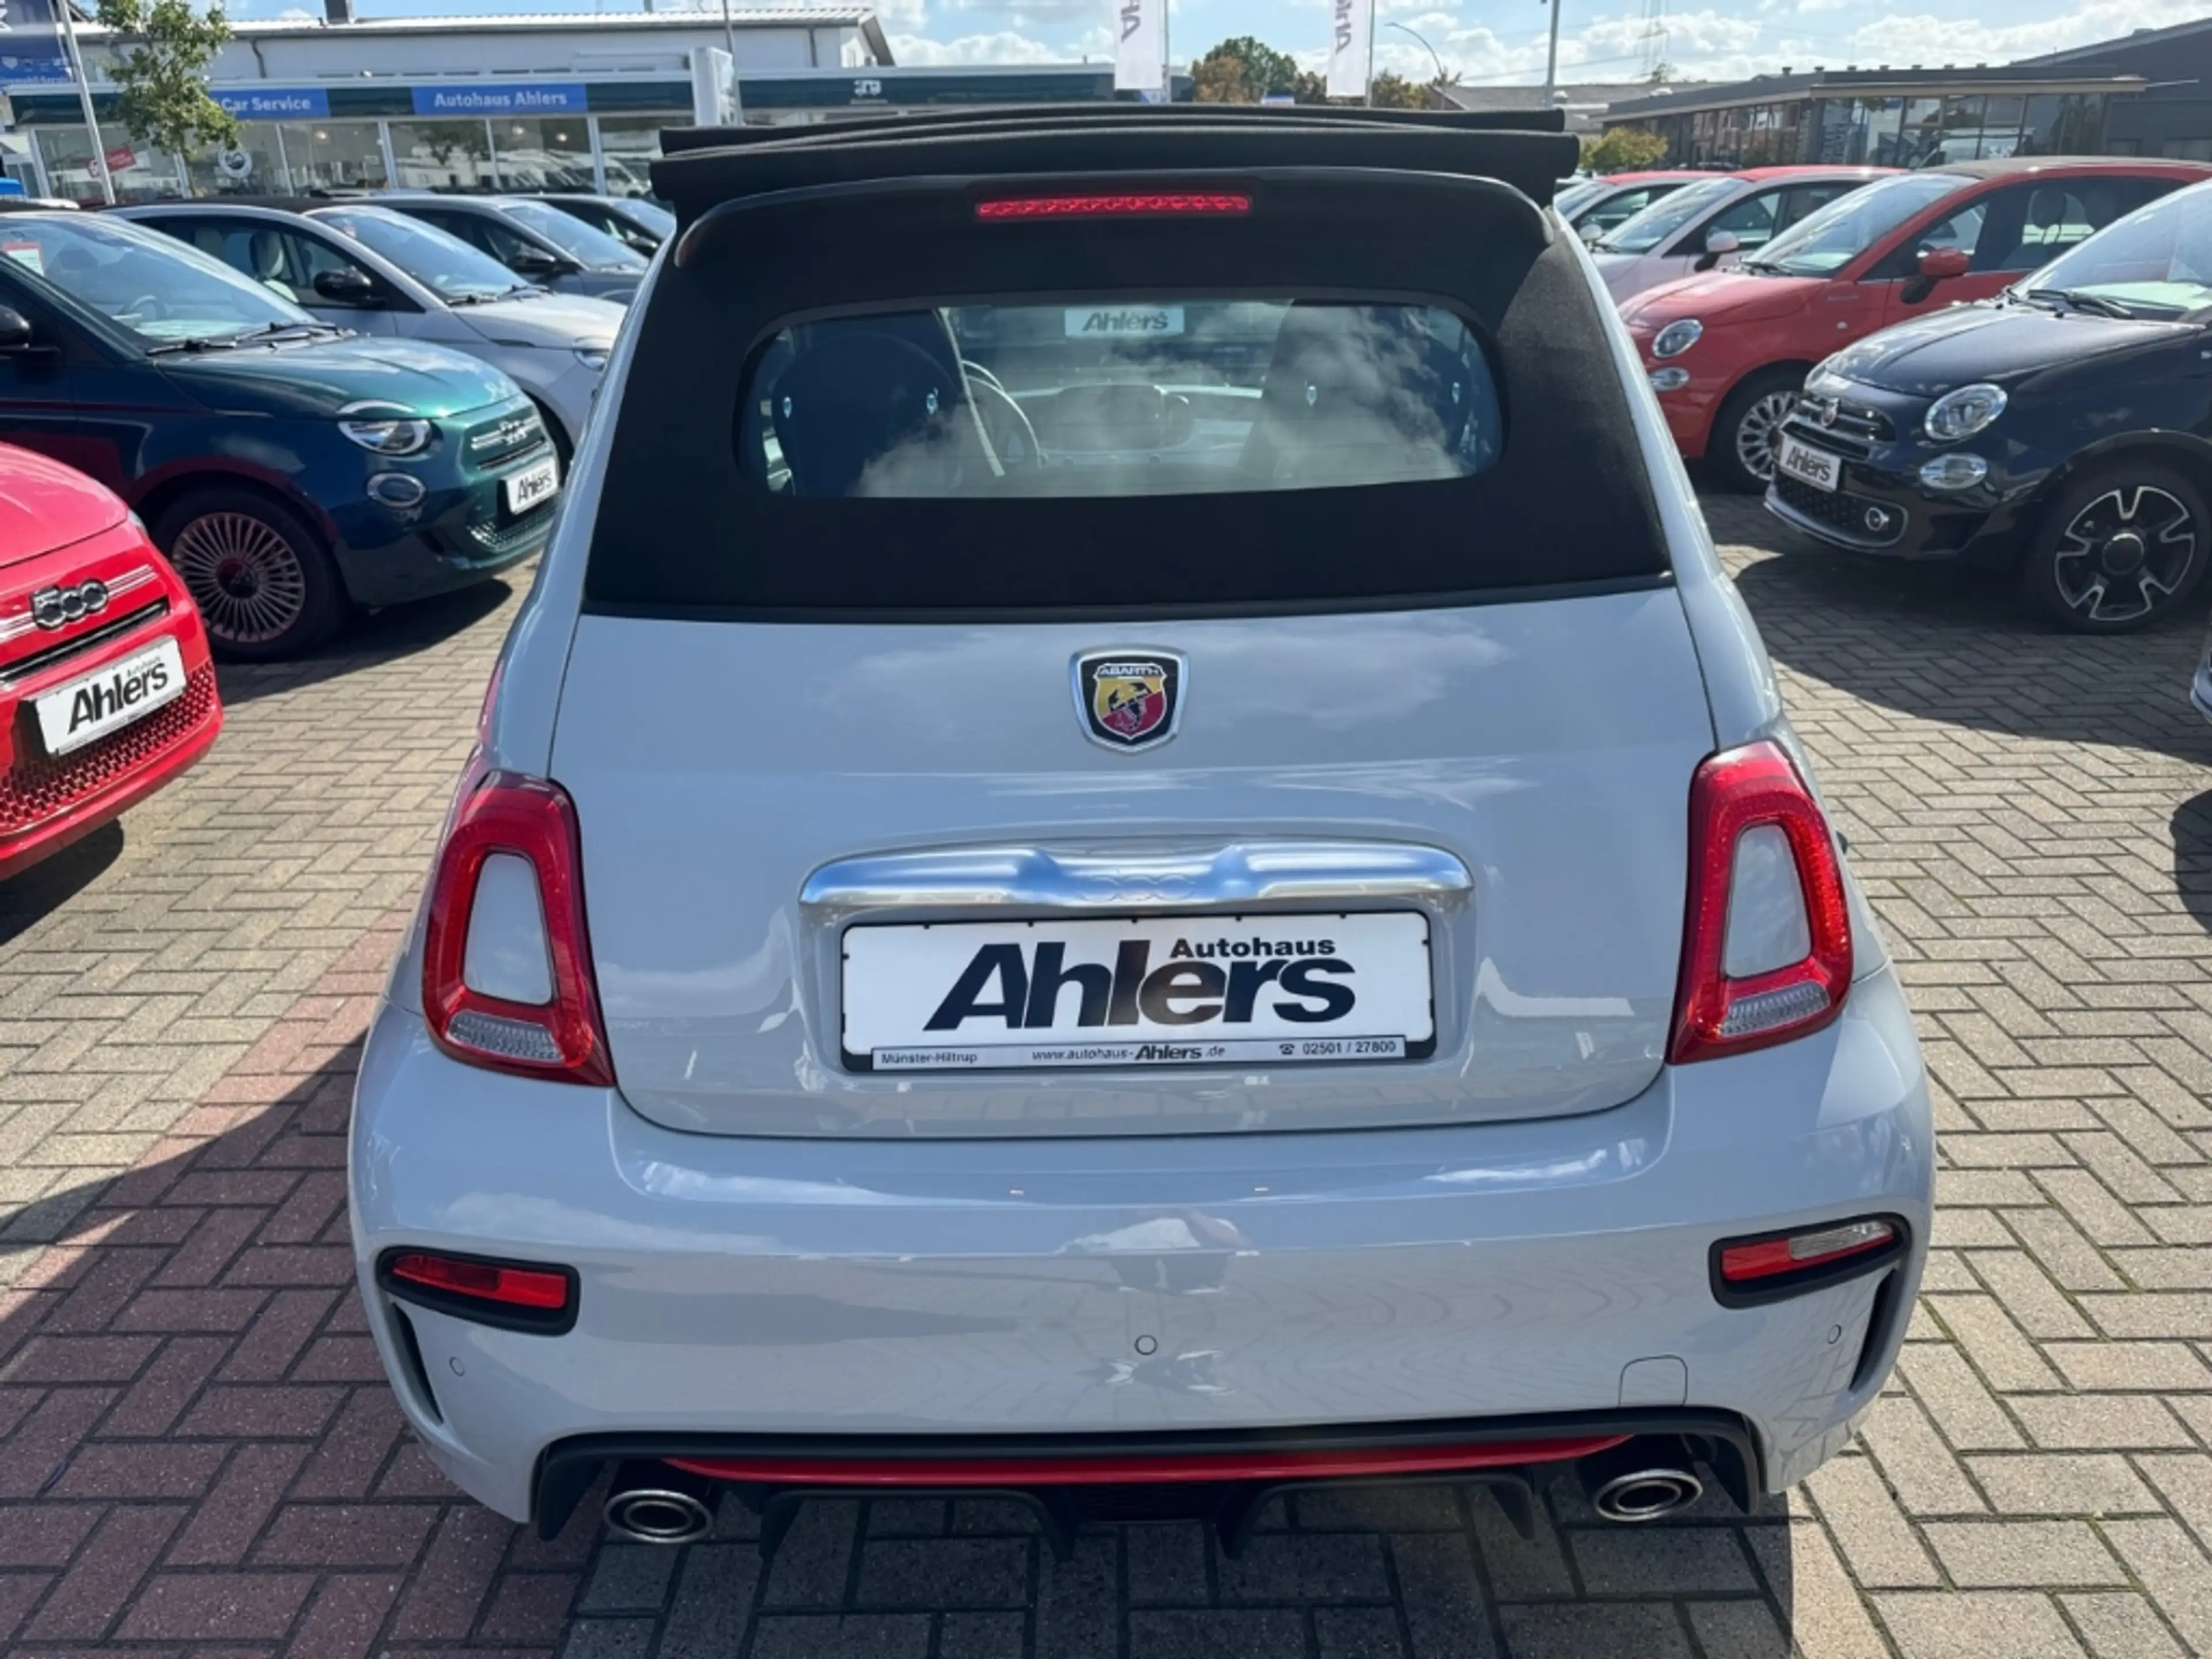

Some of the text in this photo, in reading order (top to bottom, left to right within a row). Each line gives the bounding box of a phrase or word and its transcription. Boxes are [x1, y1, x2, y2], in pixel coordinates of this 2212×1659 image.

[221, 94, 311, 112] Car Service
[434, 90, 568, 108] Autohaus Ahlers
[1081, 310, 1169, 332] Ahlers
[1785, 445, 1831, 483] Ahlers
[33, 581, 109, 630] 500
[1099, 665, 1159, 676] ABARTH
[67, 662, 169, 735] Ahlers
[1169, 937, 1336, 959] Autohaus
[922, 940, 1357, 1032] Ahlers
[881, 1052, 978, 1065] Münster-Hiltrup
[1302, 1043, 1343, 1055] 02501
[1355, 1040, 1397, 1054] 27800
